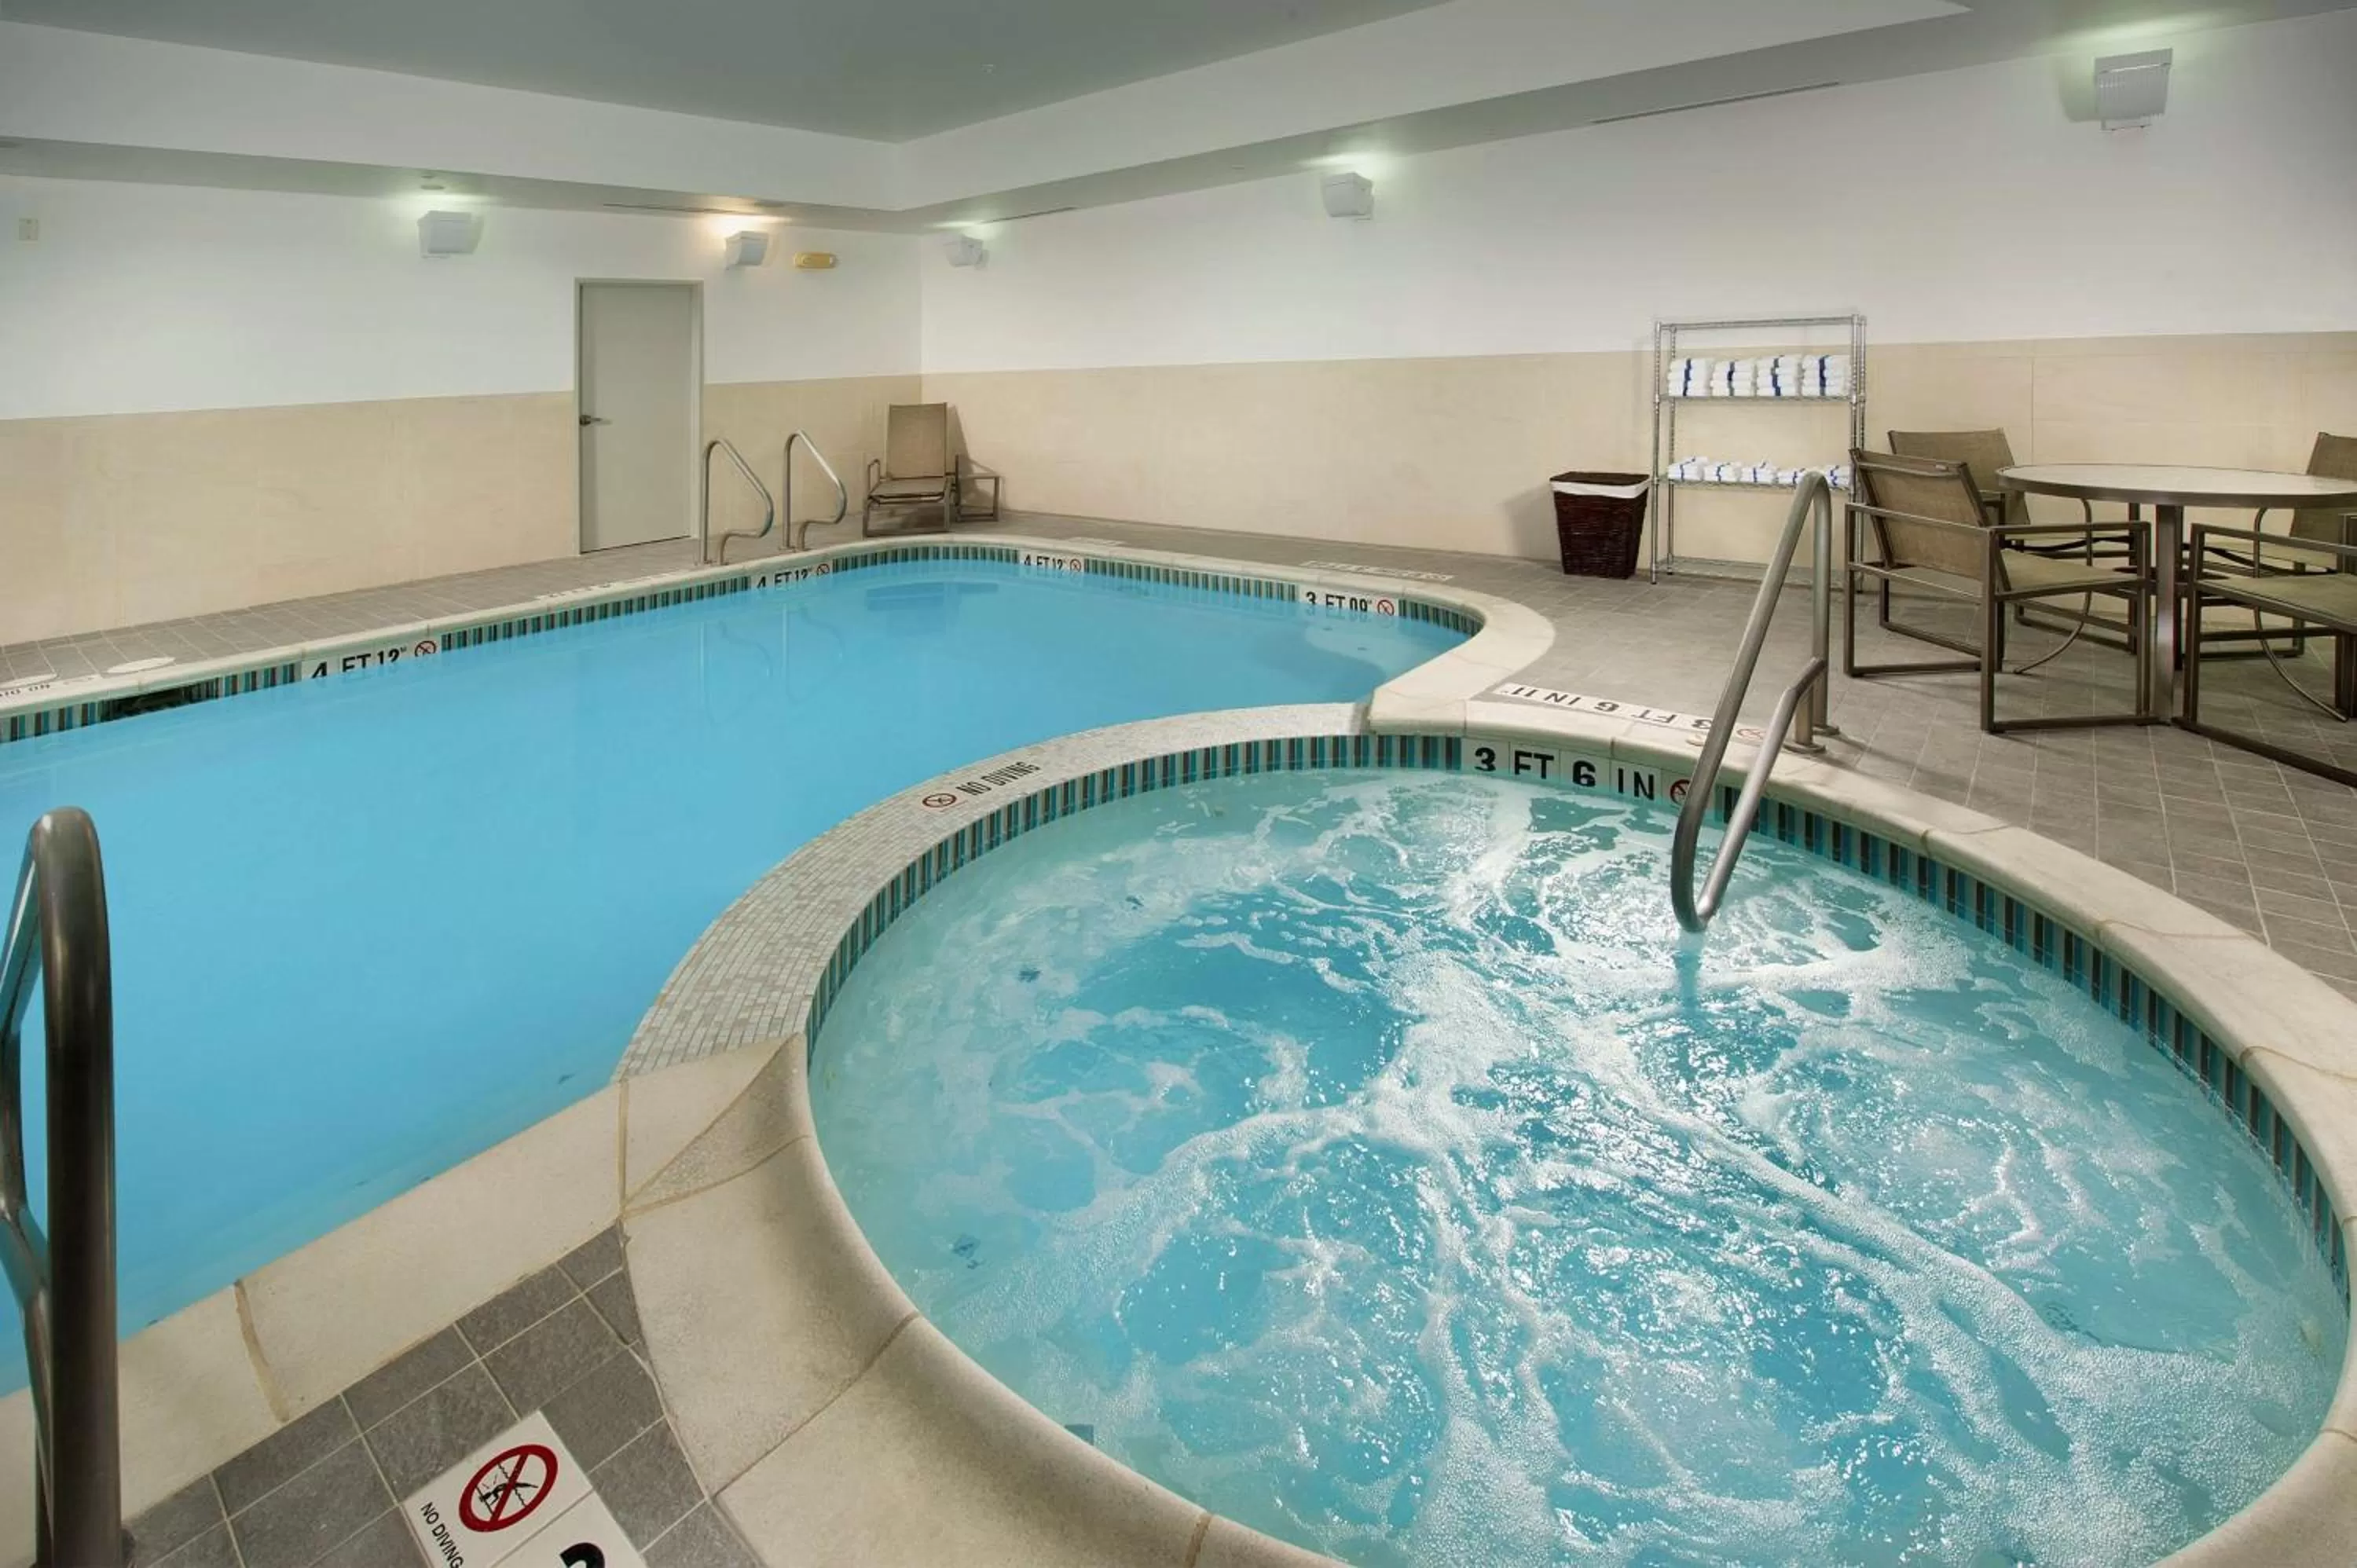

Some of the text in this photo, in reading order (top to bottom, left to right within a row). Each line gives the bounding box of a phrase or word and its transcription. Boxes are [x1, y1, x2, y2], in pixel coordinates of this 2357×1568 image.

[1036, 555, 1050, 570] FT
[775, 571, 792, 584] FT
[1306, 592, 1316, 605] 3
[1325, 593, 1346, 610] FT
[343, 653, 372, 672] FT
[1543, 693, 1582, 705] IN
[1593, 702, 1619, 712] 6
[1630, 709, 1677, 724] FT
[1691, 719, 1713, 730] 3
[955, 761, 1040, 796] NO DIVING
[1474, 747, 1655, 800] 3 FT 6 IN
[420, 1501, 464, 1568] NO DIVING
